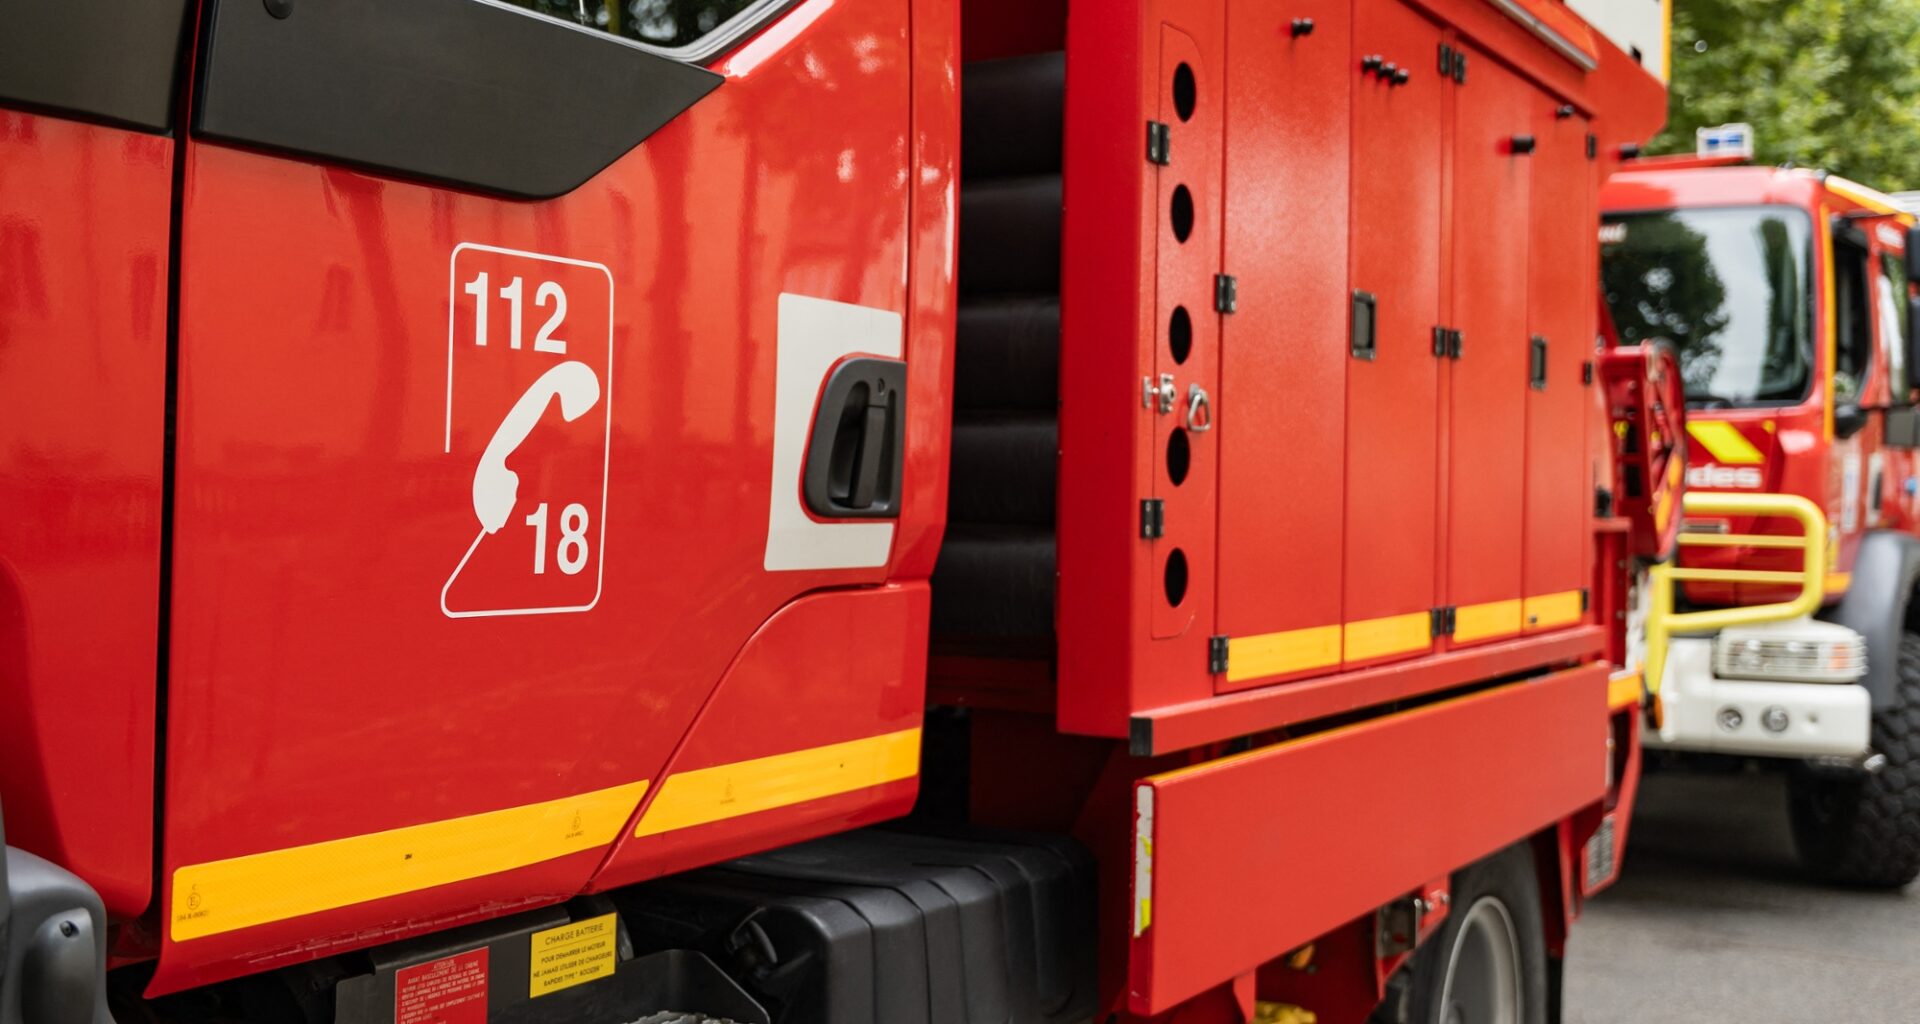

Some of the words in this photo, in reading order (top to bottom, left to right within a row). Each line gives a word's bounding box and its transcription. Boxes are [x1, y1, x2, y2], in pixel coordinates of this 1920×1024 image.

[465, 271, 567, 354] 112
[526, 503, 589, 575] 18
[545, 932, 574, 945] CHARGE
[576, 923, 604, 936] BATTERIE
[541, 954, 554, 964] POUR
[587, 940, 606, 951] MOTEUR
[578, 958, 585, 966] DE
